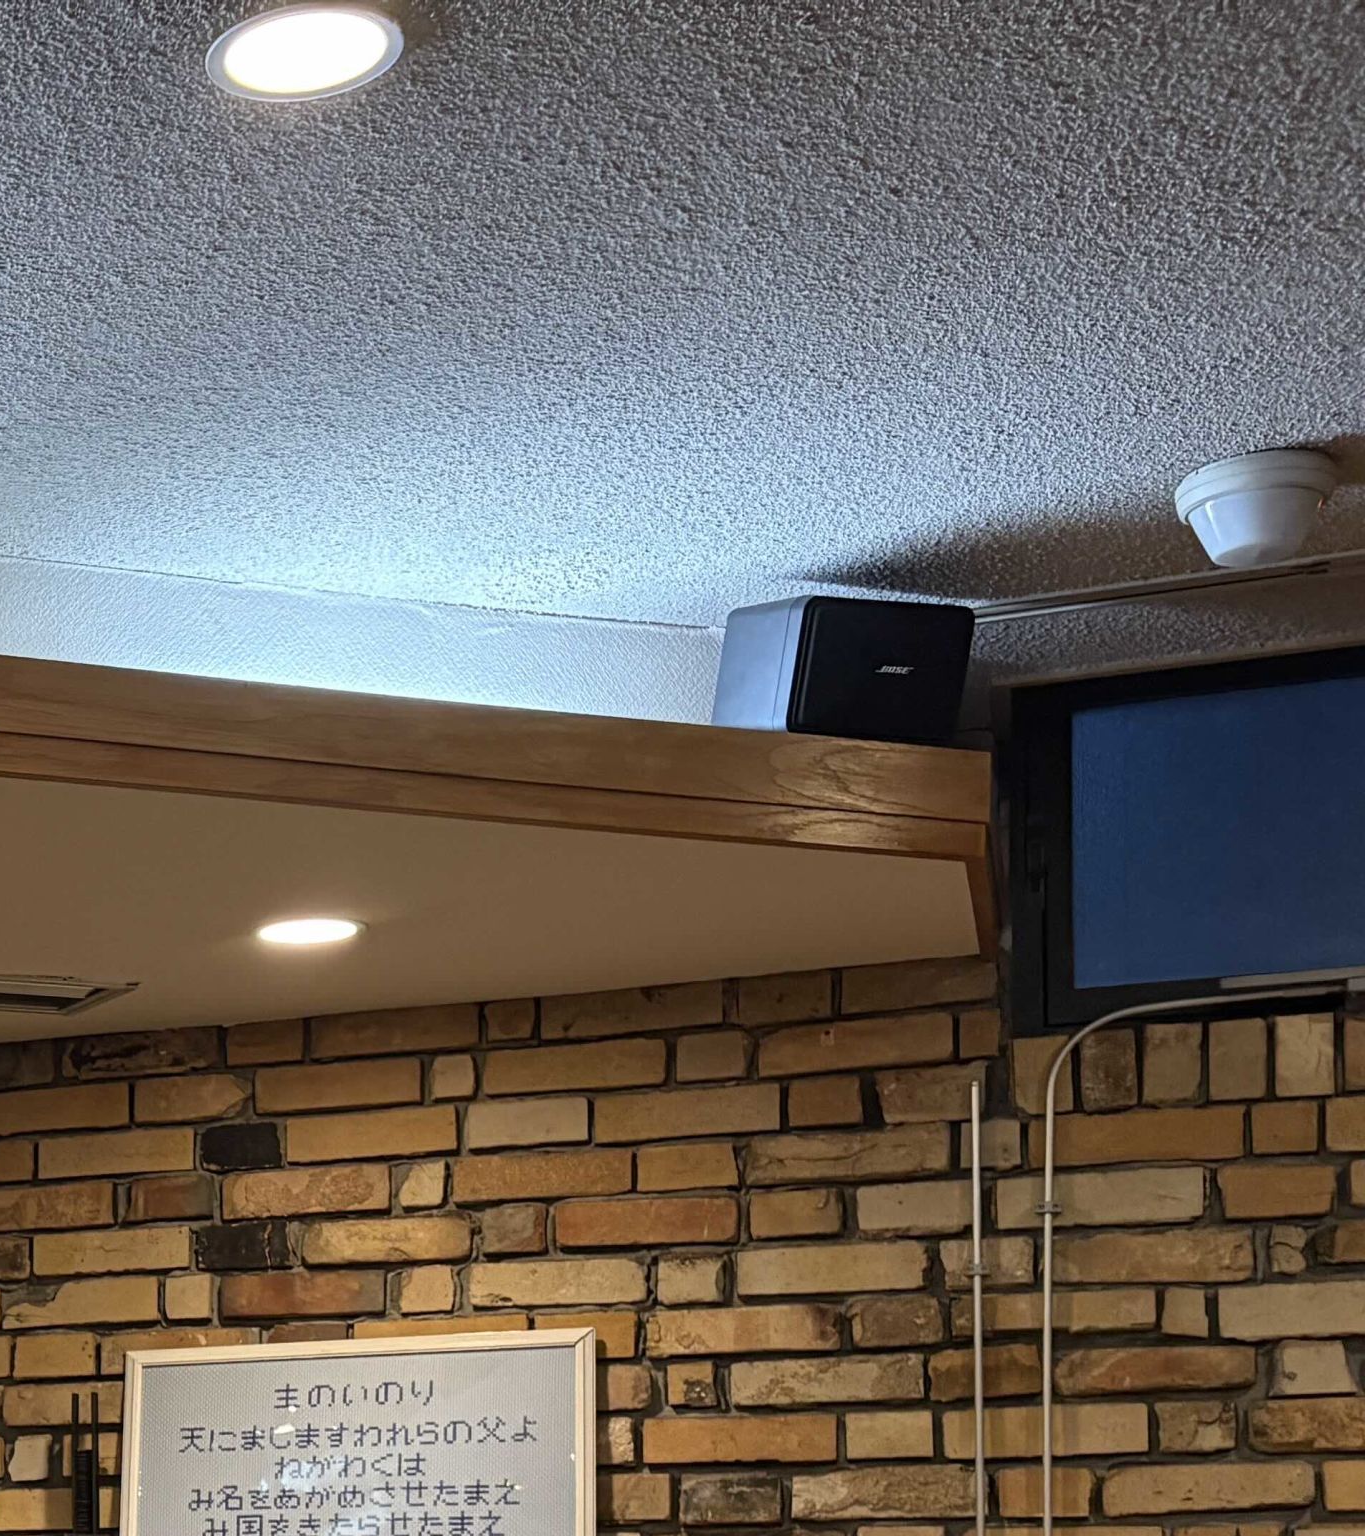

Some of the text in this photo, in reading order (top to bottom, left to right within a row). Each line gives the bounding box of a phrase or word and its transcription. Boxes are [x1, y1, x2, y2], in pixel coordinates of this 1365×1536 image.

[874, 664, 915, 675] BOSE
[274, 1380, 435, 1409] 主のいのり
[179, 1416, 537, 1453] 天にましますわれらの父よ
[274, 1453, 427, 1480] ねがわくは
[188, 1480, 521, 1511] み名をあがめさせたまえ
